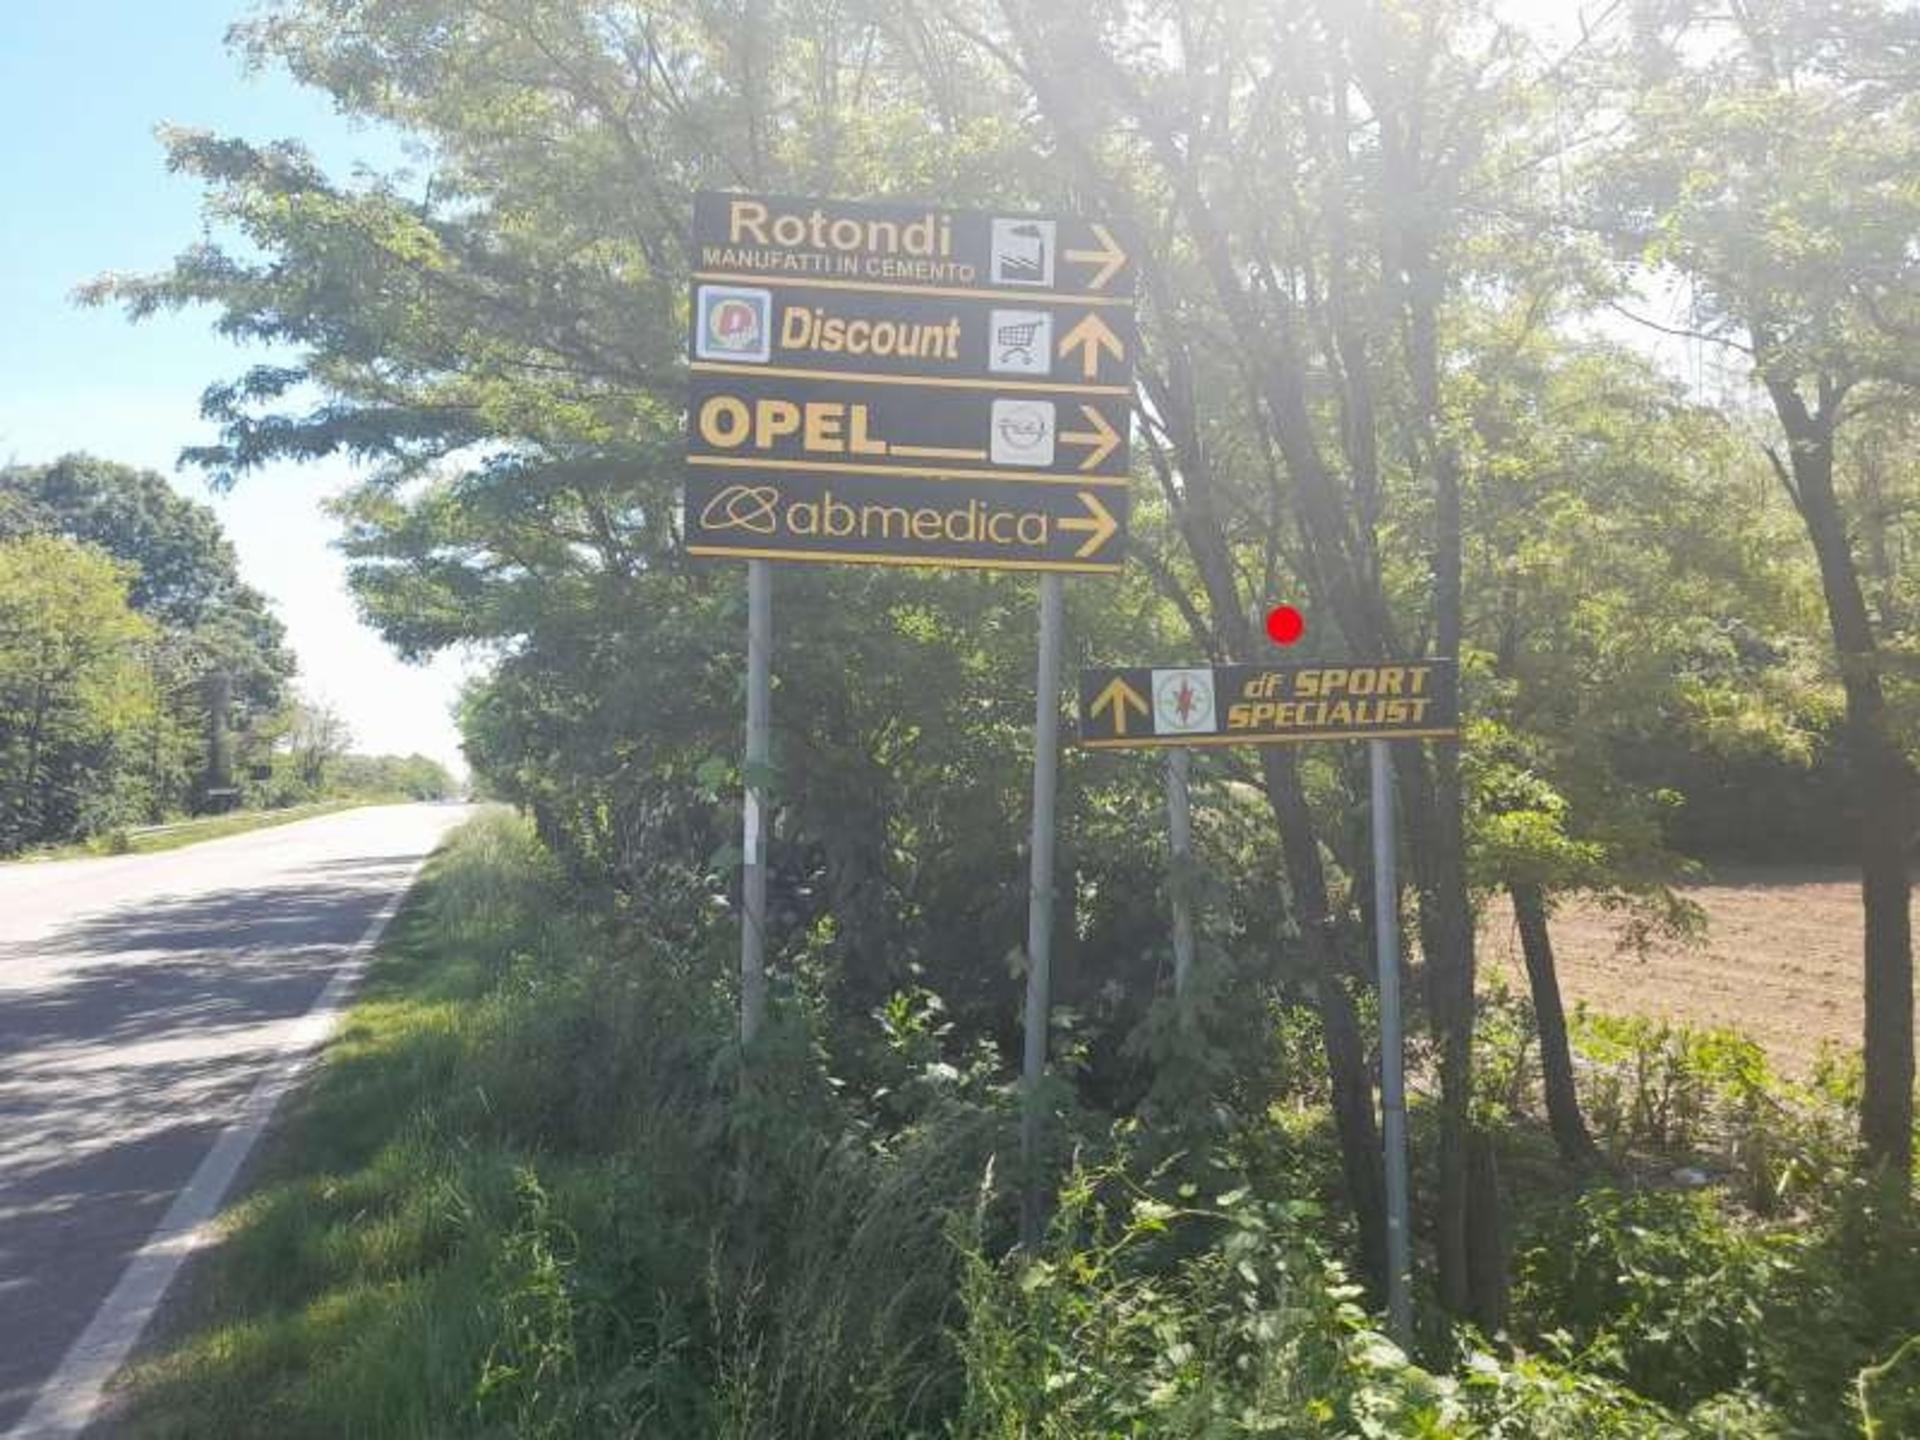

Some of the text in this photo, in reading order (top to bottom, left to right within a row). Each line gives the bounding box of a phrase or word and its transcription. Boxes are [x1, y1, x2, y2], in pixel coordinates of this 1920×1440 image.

[730, 200, 951, 256] Rotondi
[703, 247, 976, 282] MANUFATTI IN CEMENTO
[782, 305, 961, 359] Discount
[699, 395, 888, 455] OPEL
[786, 491, 1048, 546] abmedica
[1294, 667, 1431, 696] SPORT
[1228, 699, 1427, 729] SPECIALIST
